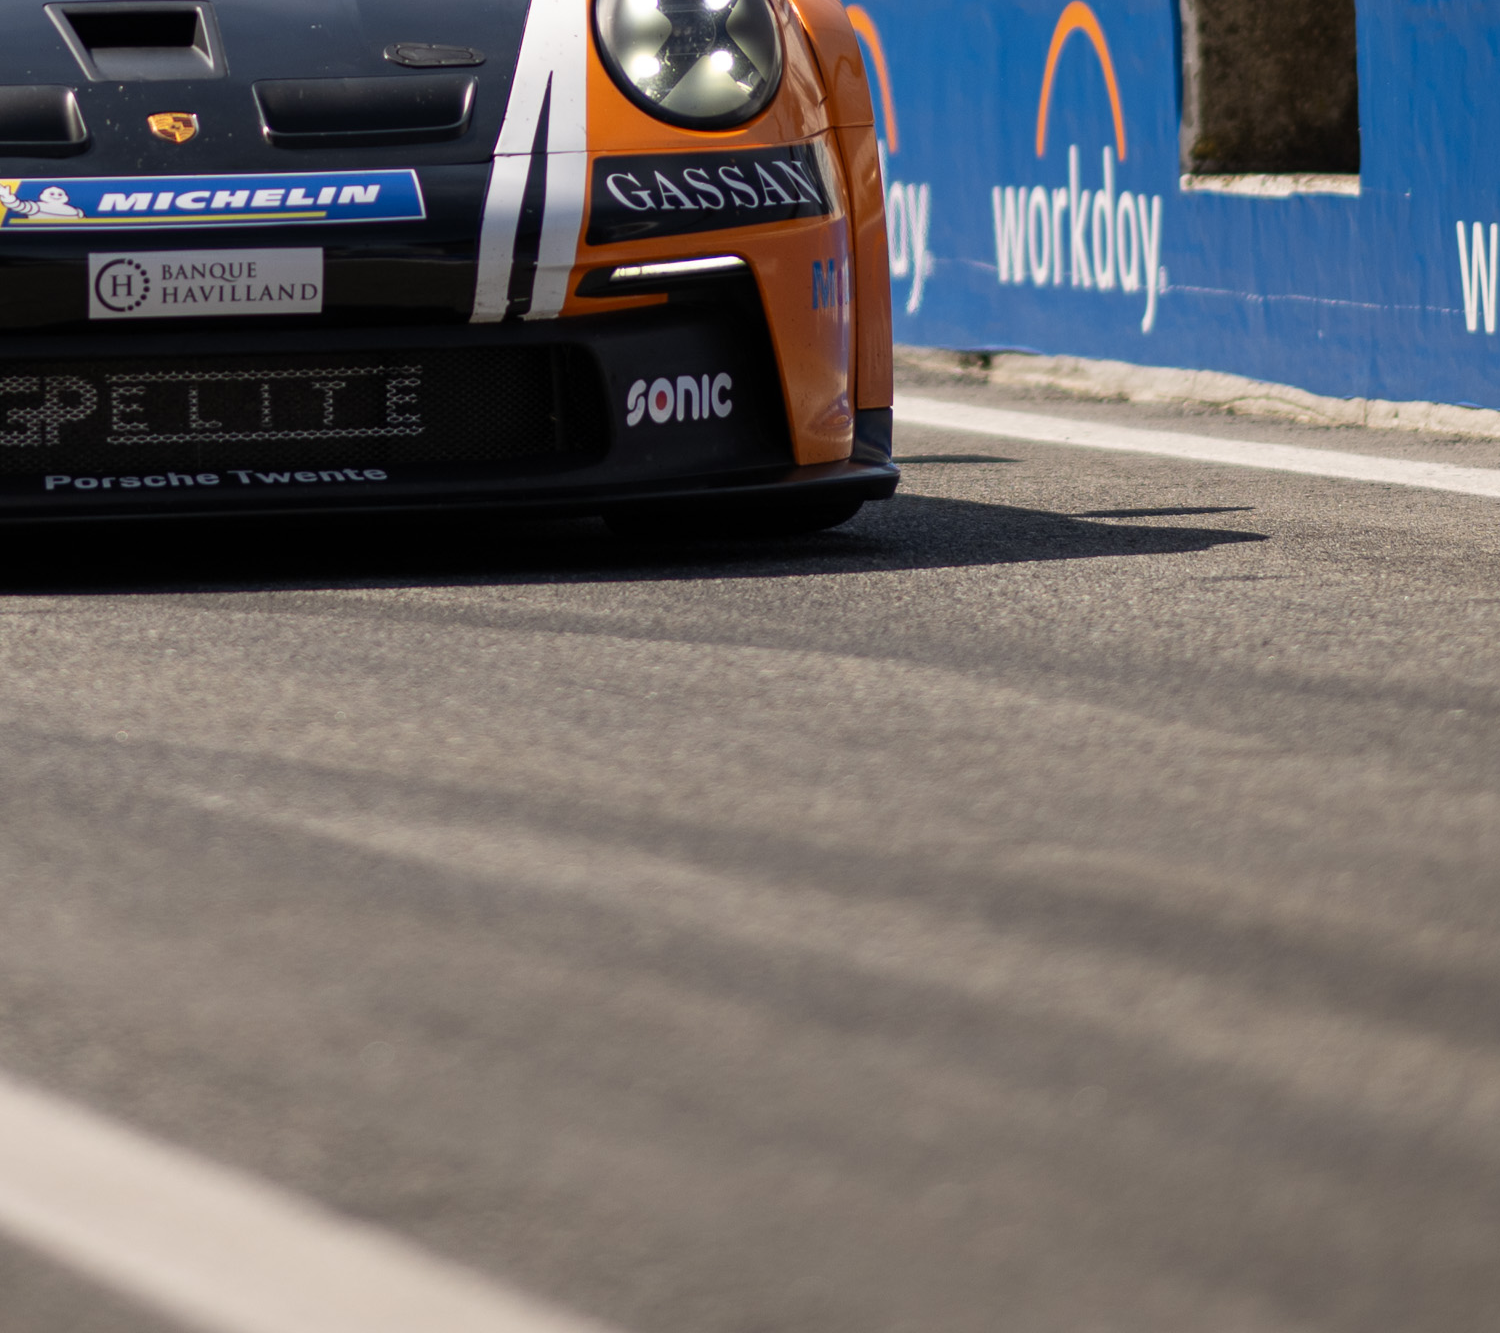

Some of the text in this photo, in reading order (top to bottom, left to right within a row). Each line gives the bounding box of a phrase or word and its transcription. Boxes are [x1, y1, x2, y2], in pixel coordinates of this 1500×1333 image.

[97, 183, 382, 212] MICHELIN
[605, 159, 823, 212] GASSAN
[161, 261, 258, 282] BANQUE
[161, 282, 319, 305] HAVILLAND
[44, 466, 389, 491] Porsche Twente
